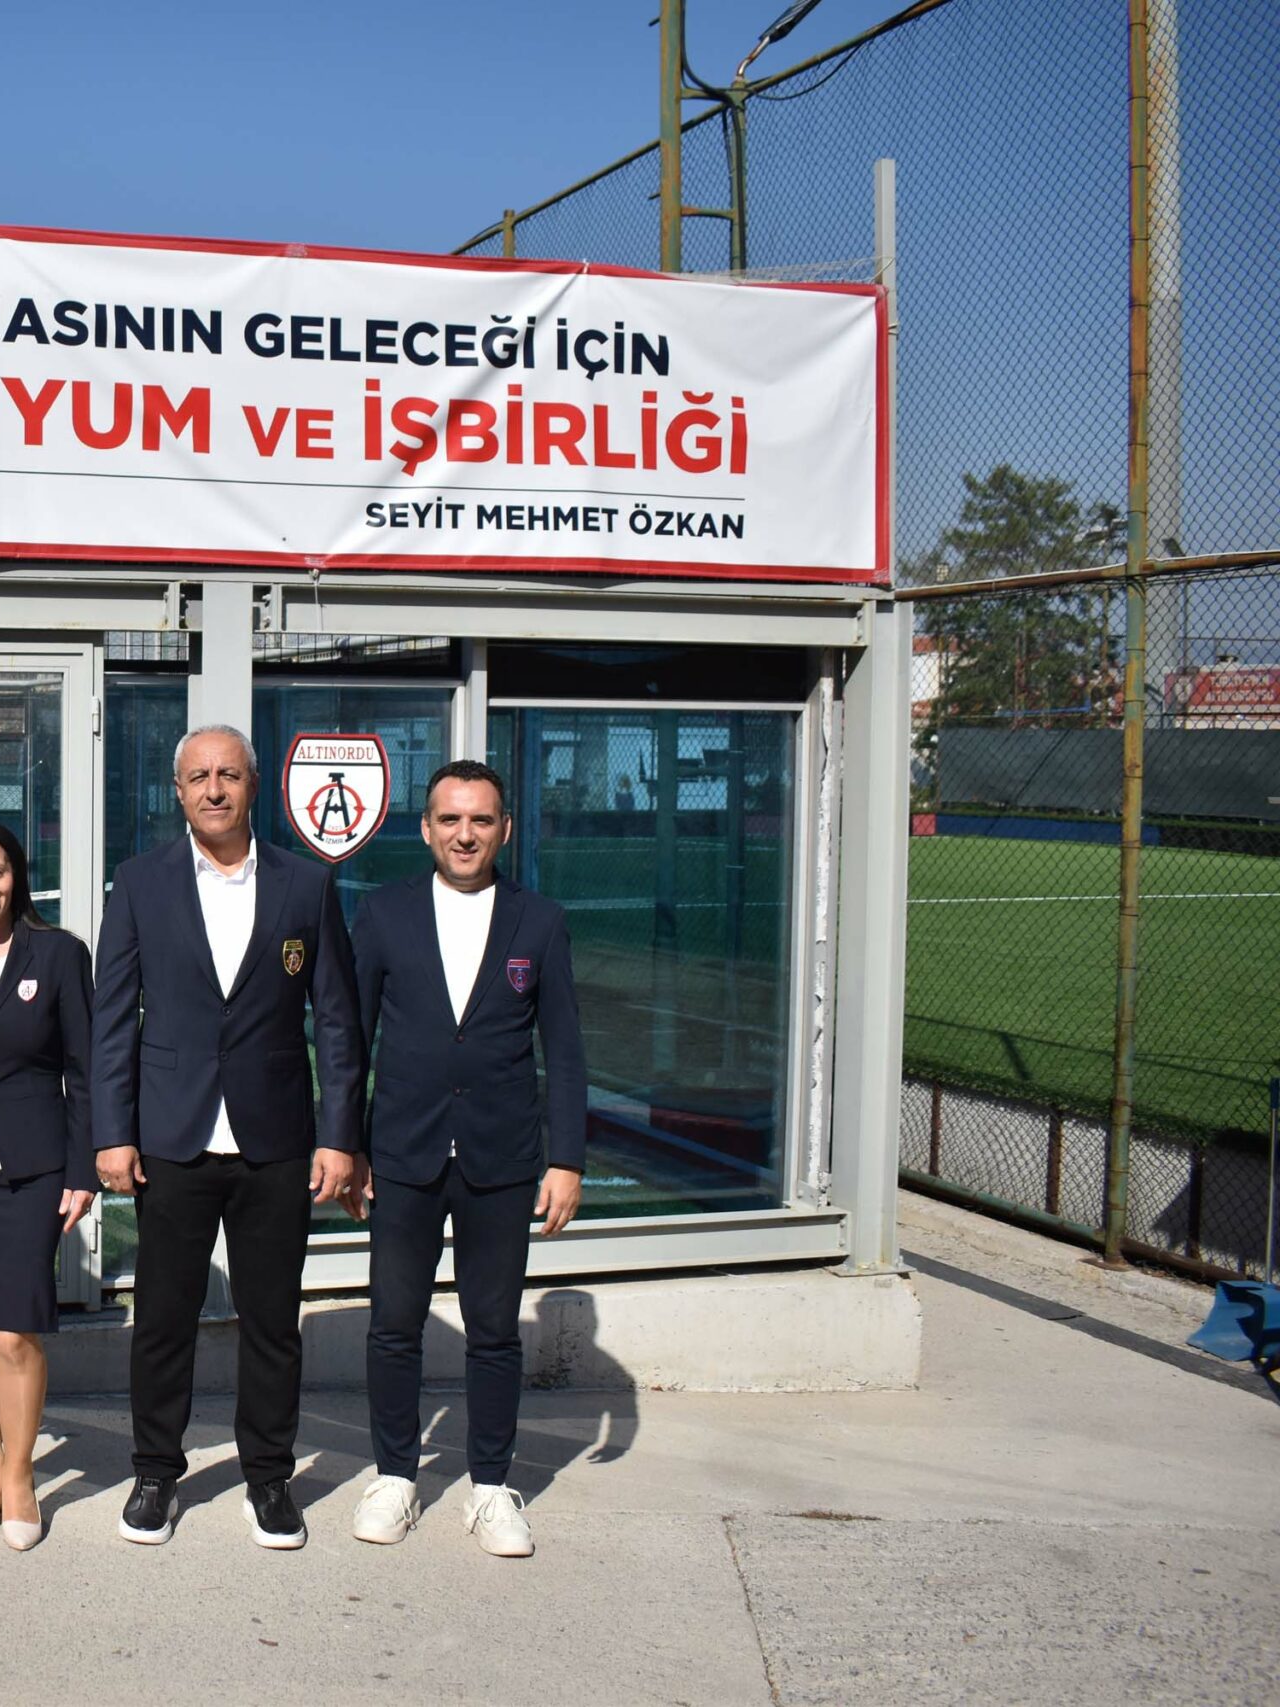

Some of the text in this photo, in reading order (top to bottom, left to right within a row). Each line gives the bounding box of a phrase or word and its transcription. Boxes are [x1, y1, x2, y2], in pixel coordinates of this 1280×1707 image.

[245, 314, 536, 369] GELECEĞİ
[557, 319, 669, 380] İÇİN
[243, 406, 333, 459] VE
[365, 379, 747, 476] İŞBİRLİĞİ
[367, 497, 743, 538] SEYİT MEHMET ÖZKAN
[297, 746, 374, 760] ALTINORDU
